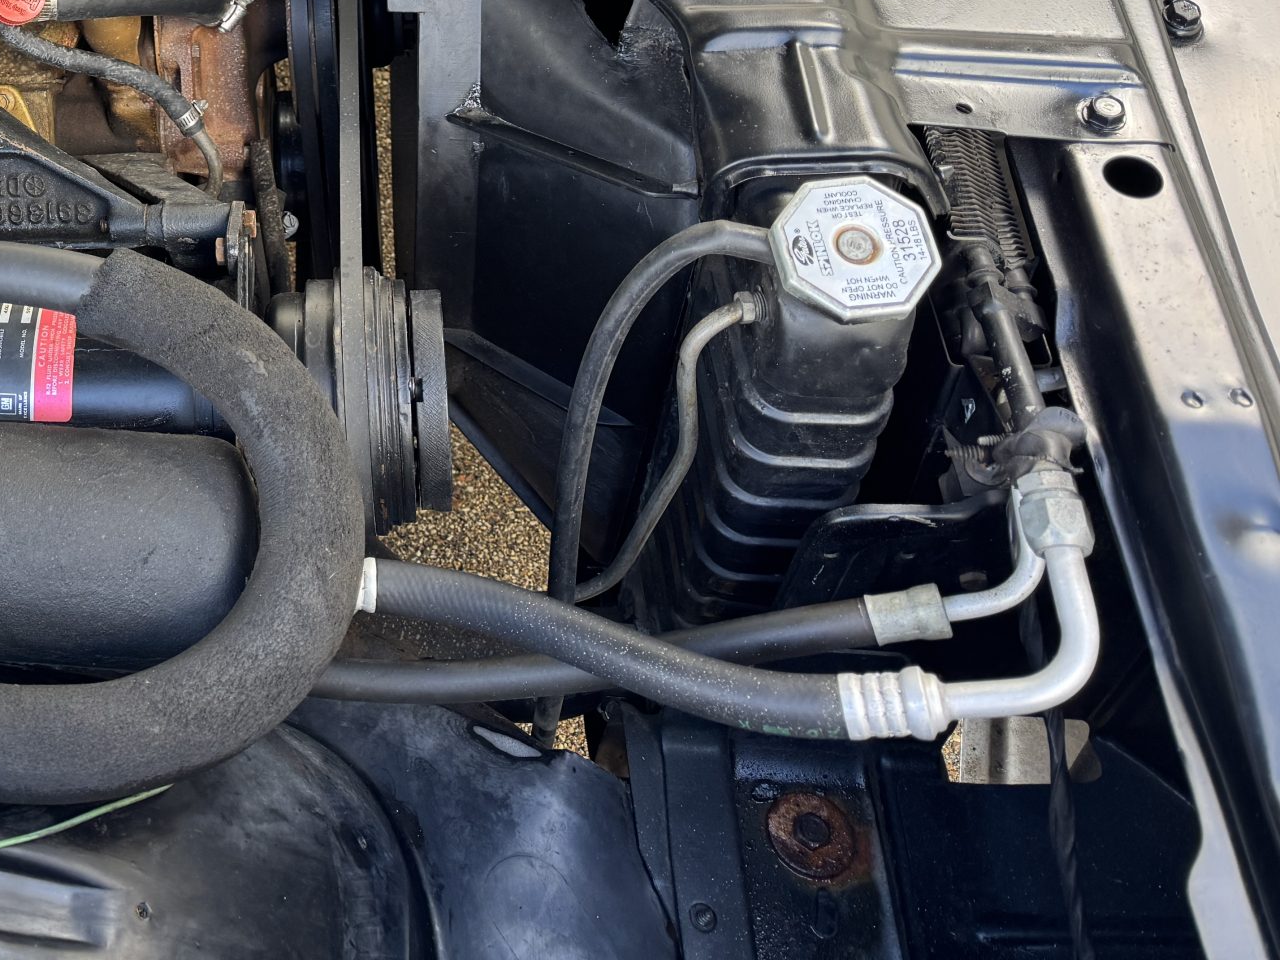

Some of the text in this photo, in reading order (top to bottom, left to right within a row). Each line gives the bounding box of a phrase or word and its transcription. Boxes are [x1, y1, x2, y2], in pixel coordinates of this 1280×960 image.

[825, 190, 857, 199] COOLANT
[824, 198, 861, 206] CHANGING
[816, 203, 873, 214] REPLACE WHEN
[874, 199, 908, 285] CAUTION PRESSURE
[892, 219, 917, 262] 31528
[908, 220, 928, 261] 14-18 LBS
[846, 274, 890, 285] WHEN HOT
[841, 286, 865, 294] OPEN
[886, 282, 899, 290] DO
[848, 290, 897, 302] WARNING
[38, 324, 50, 368] CAUTION
[1, 397, 10, 411] GM
